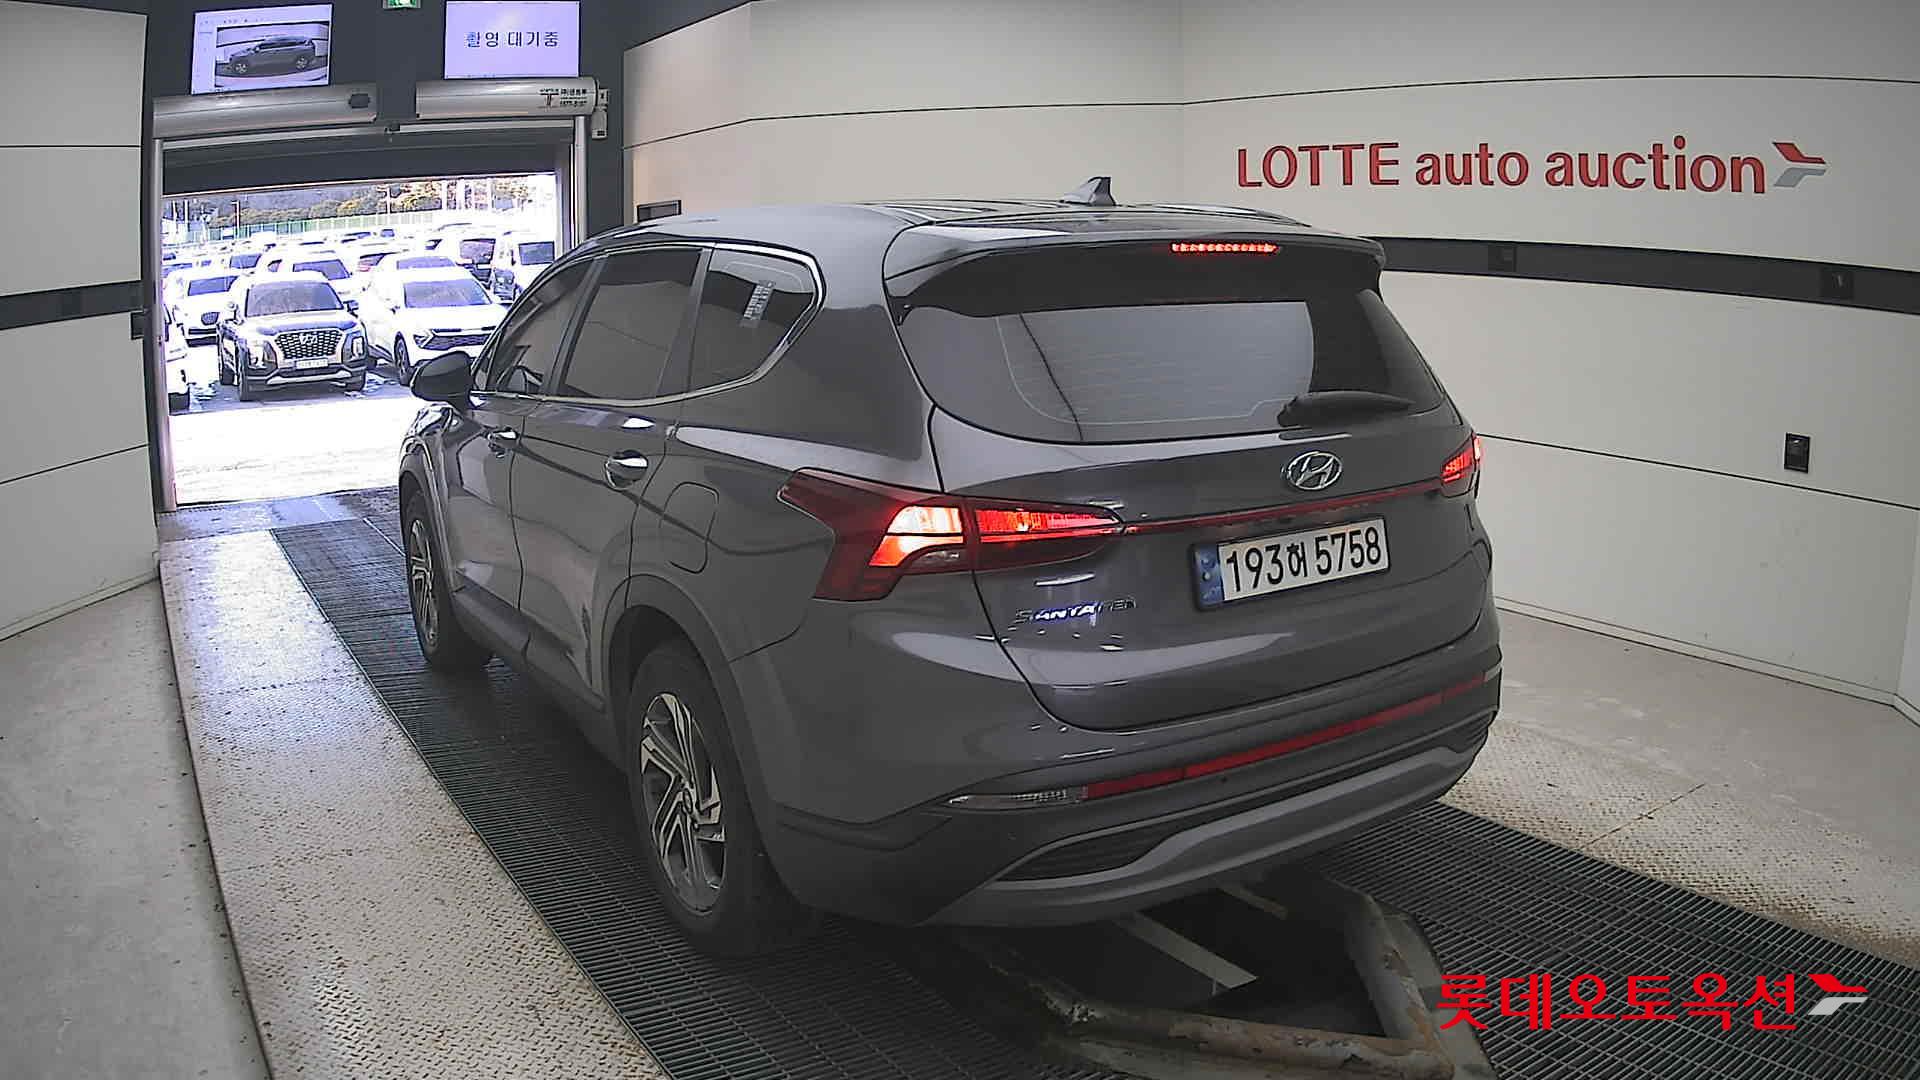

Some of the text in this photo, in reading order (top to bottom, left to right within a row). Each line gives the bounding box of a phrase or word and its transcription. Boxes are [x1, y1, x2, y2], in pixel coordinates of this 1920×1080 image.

[507, 31, 559, 48] 대기중
[1237, 135, 1767, 194] LOTTE auto auction
[1226, 526, 1382, 592] 193허 5758
